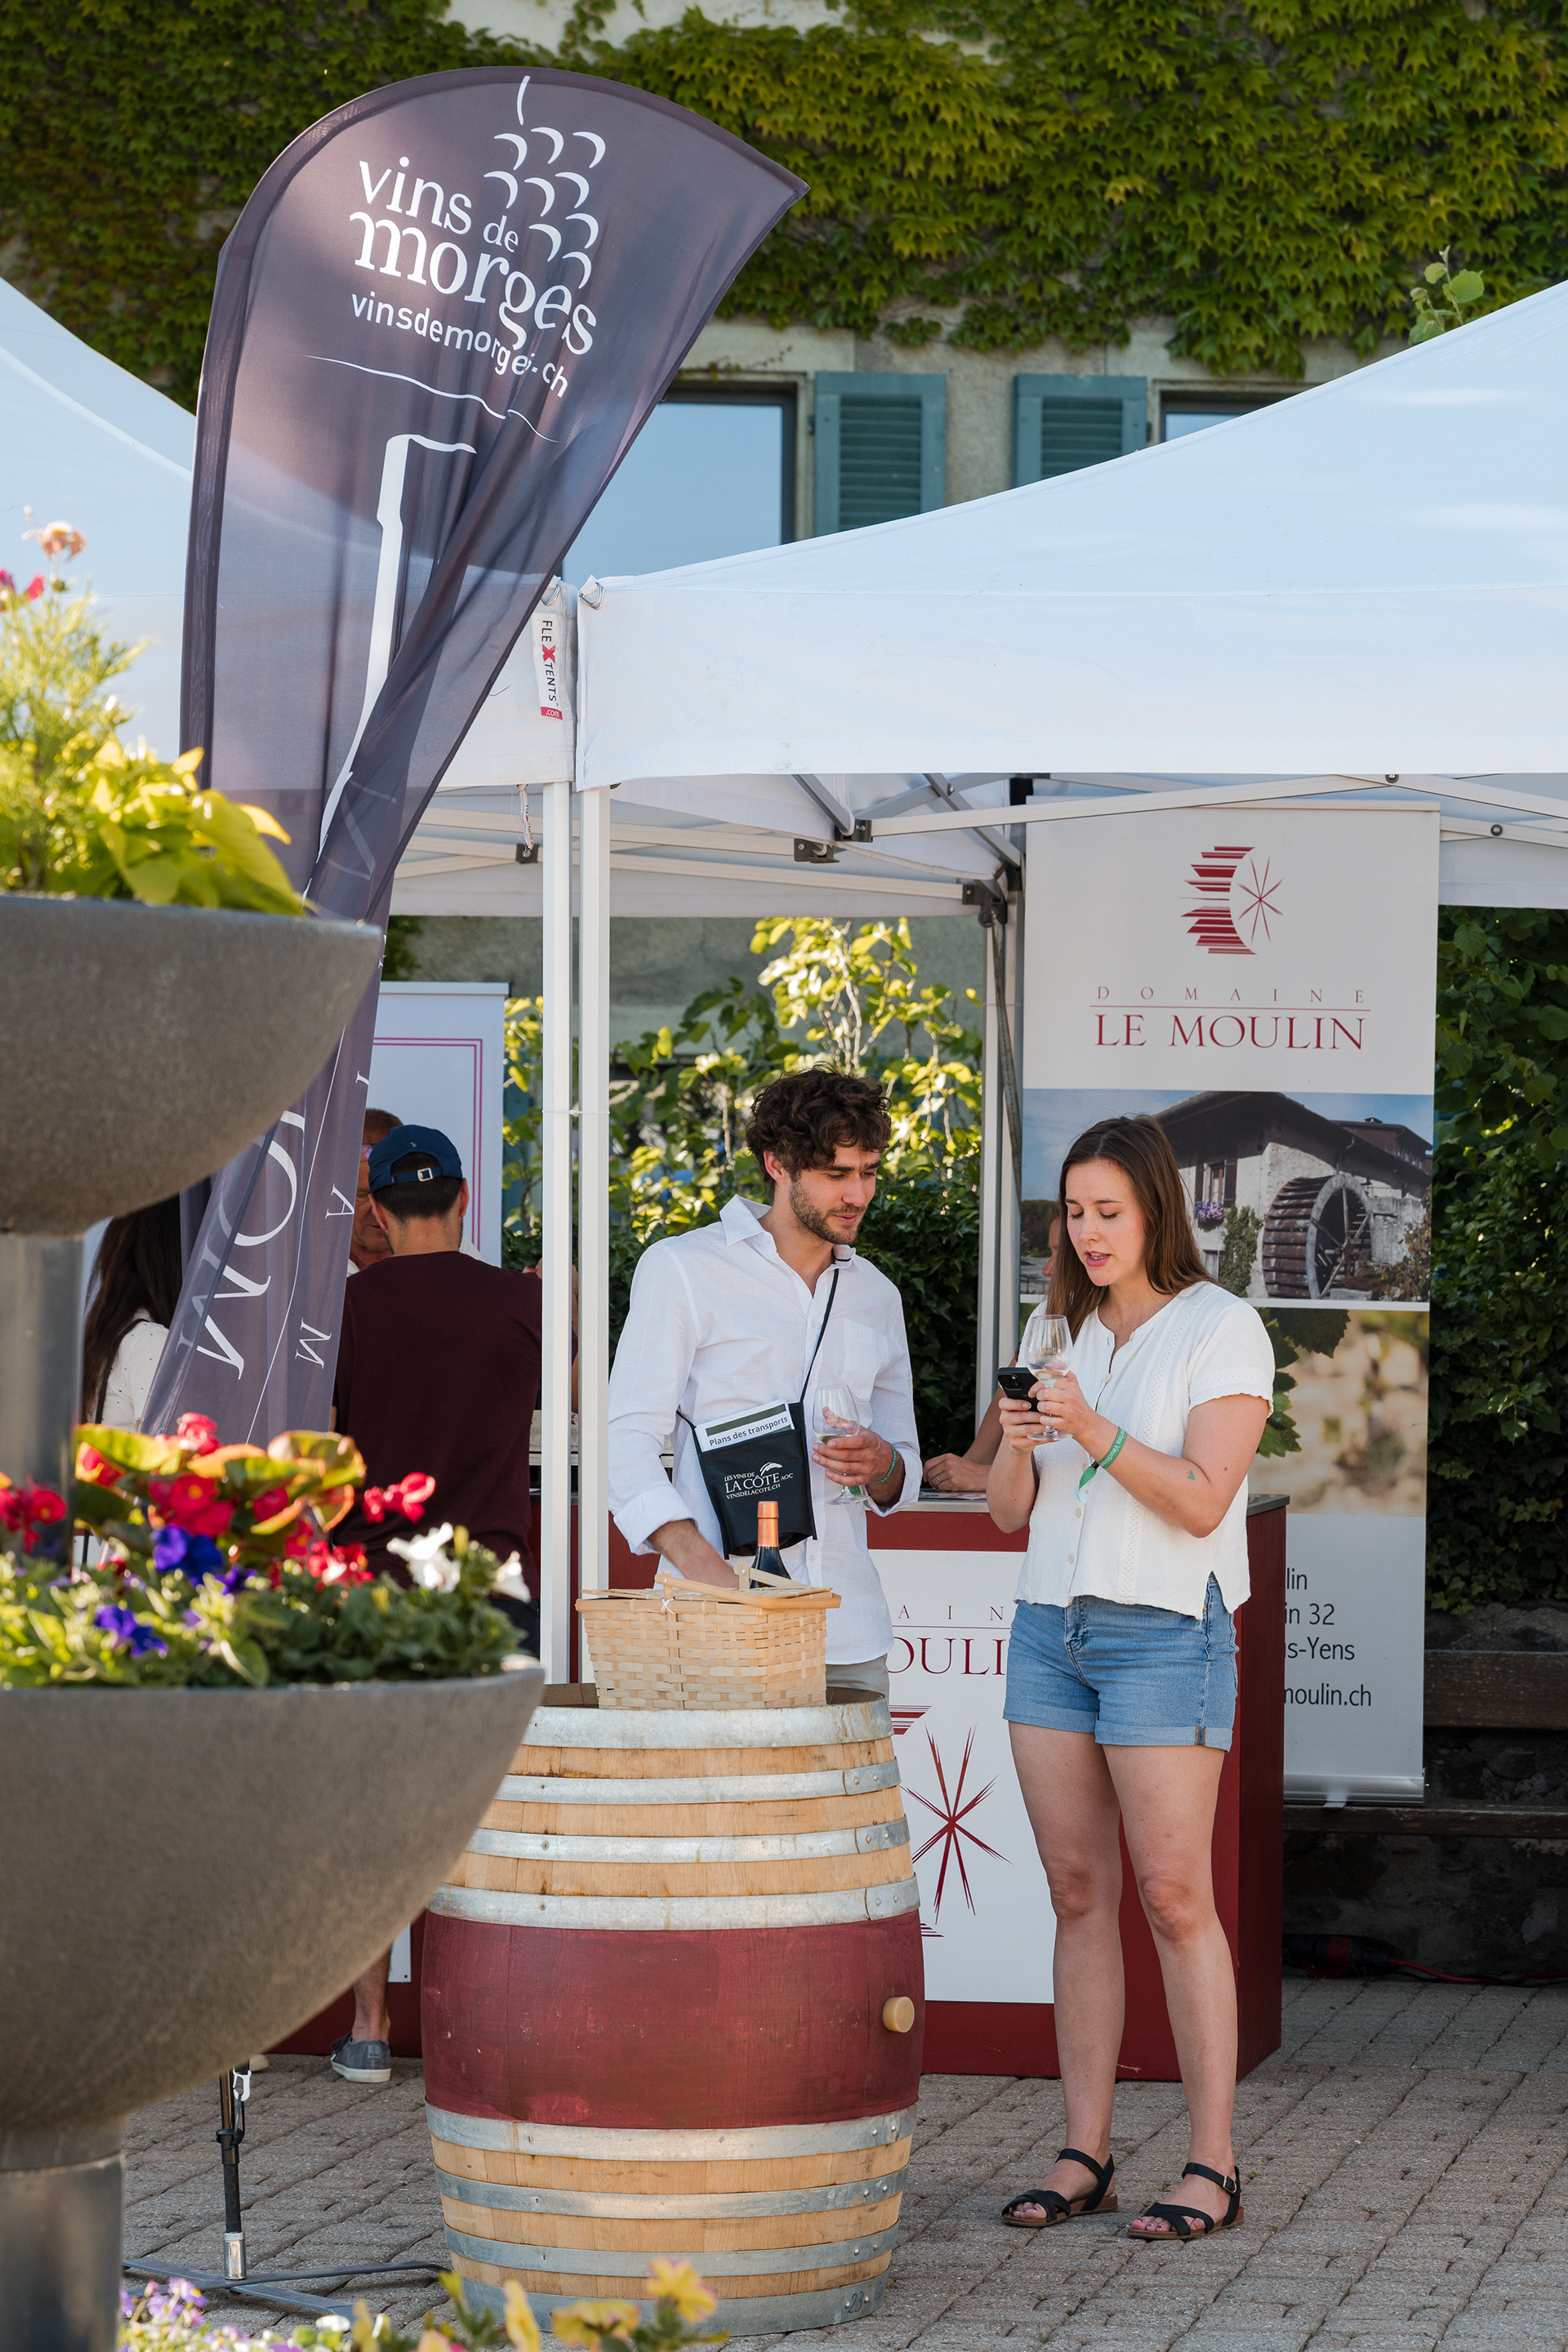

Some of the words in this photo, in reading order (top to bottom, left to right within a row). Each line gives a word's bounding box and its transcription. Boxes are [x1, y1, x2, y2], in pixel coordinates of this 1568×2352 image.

[359, 156, 472, 234] vins
[483, 215, 519, 252] de
[350, 211, 597, 355] morges
[1097, 986, 1364, 1004] DOMAINE
[1094, 1013, 1147, 1046] LE
[1169, 1014, 1365, 1050] MOULIN
[709, 1435, 732, 1446] Plans
[733, 1431, 747, 1440] des
[748, 1415, 788, 1435] transports
[724, 1474, 733, 1482] LES
[725, 1480, 742, 1494] LA
[742, 1472, 781, 1490] CÔTE
[780, 1472, 794, 1481] AOC
[1308, 1602, 1335, 1625] 32
[1284, 1636, 1356, 1660] s-Yens
